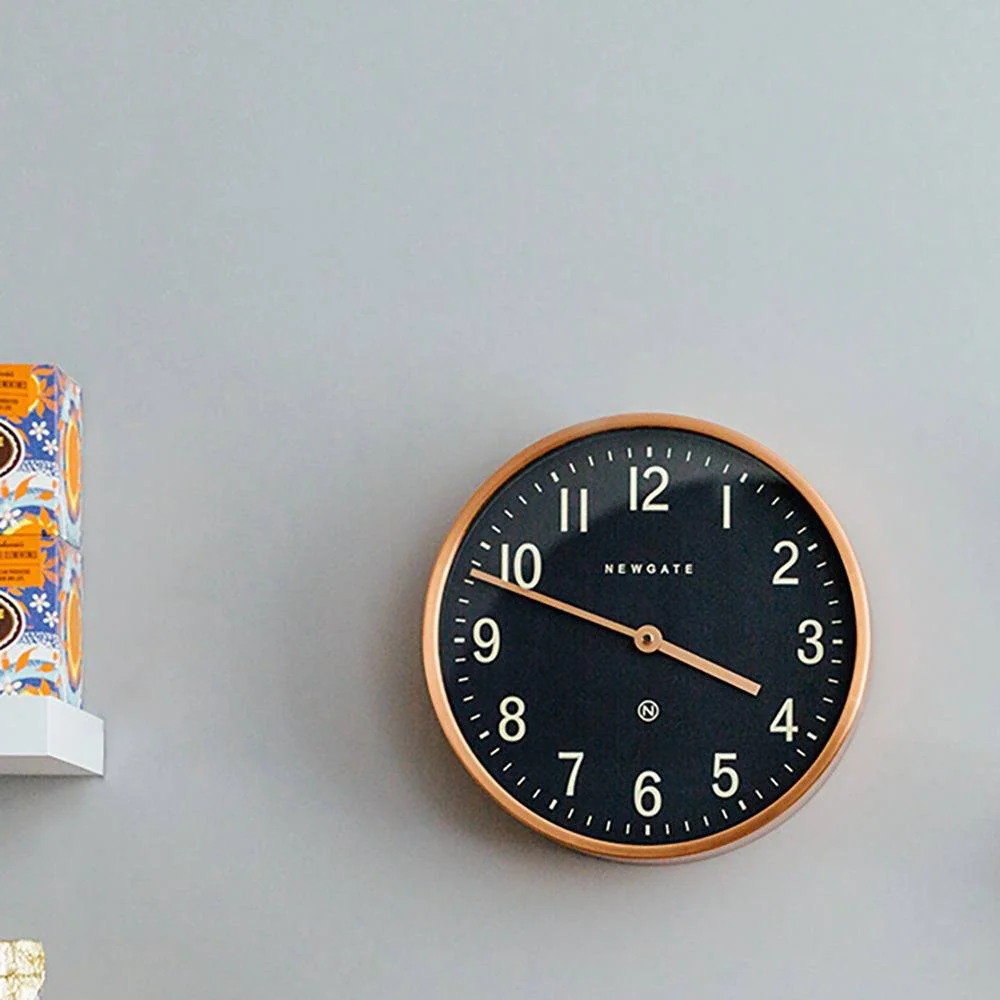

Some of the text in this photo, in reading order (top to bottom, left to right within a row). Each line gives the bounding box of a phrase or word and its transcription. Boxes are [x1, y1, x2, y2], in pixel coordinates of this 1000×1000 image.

[560, 488, 588, 533] 11
[629, 466, 670, 512] 12
[722, 485, 731, 529] 1
[502, 543, 542, 590] 10
[604, 563, 694, 575] NEWGATE
[772, 540, 799, 585] 2
[473, 618, 501, 663] 9
[797, 620, 824, 665] 3
[500, 696, 526, 742] 8
[769, 698, 798, 742] 4
[557, 752, 584, 796] 7
[633, 771, 662, 817] 6
[712, 753, 739, 798] 5
